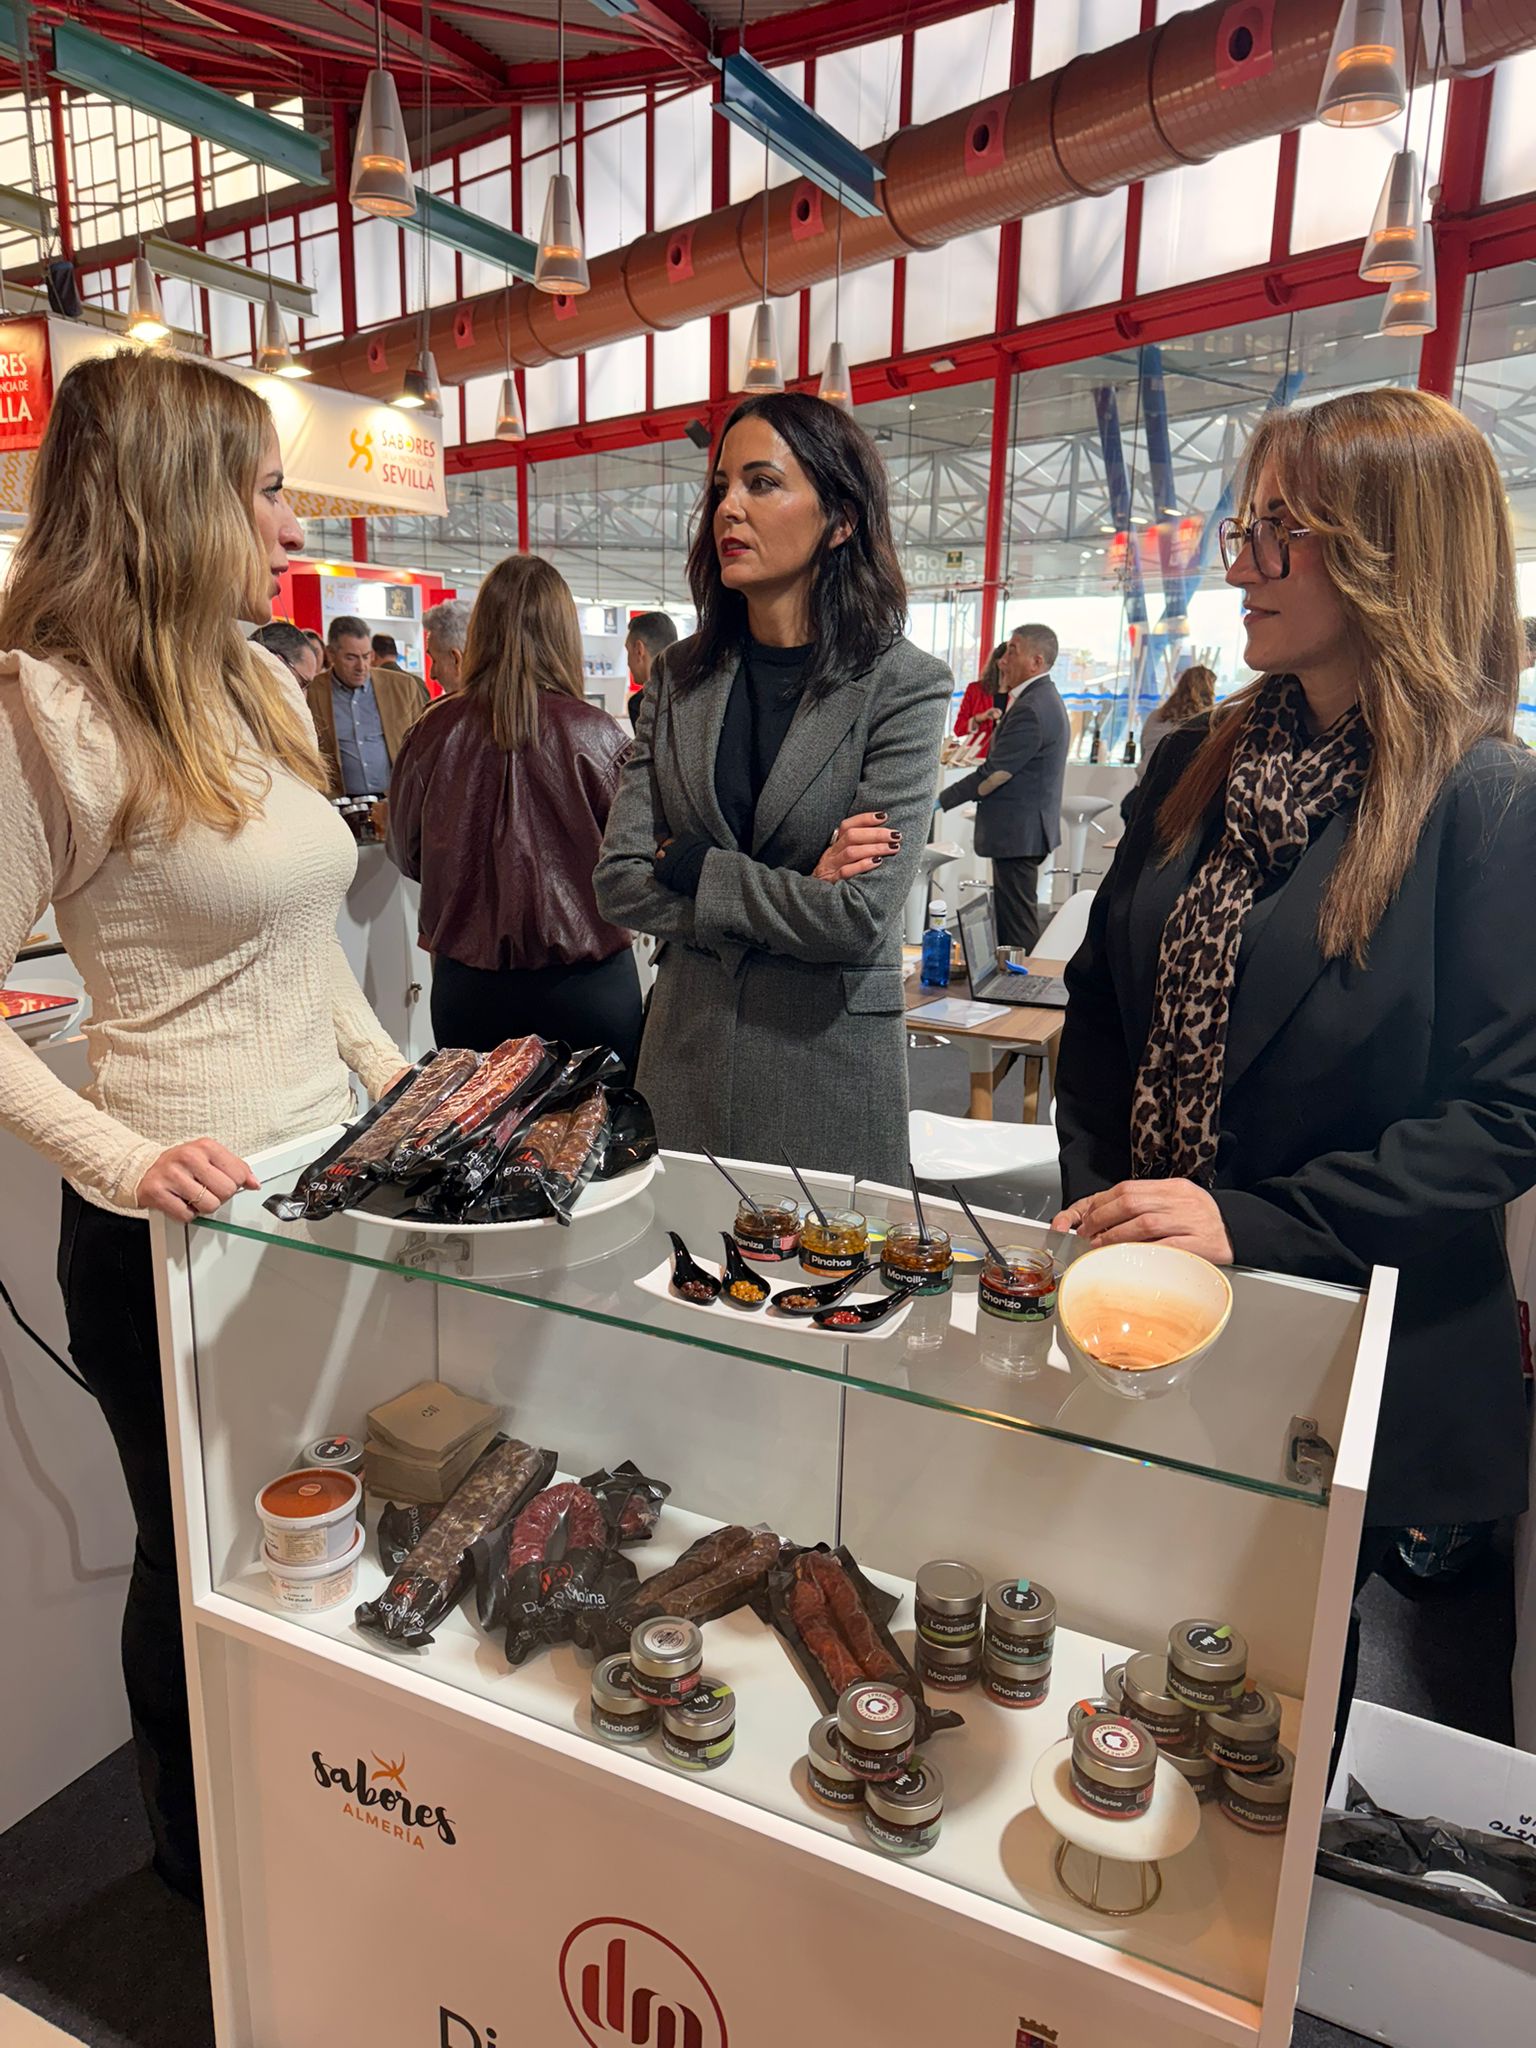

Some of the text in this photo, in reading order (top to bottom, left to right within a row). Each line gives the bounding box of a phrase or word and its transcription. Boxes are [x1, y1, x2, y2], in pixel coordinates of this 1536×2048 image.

[382, 430, 436, 458] SABORES
[383, 463, 436, 493] SEVILLA
[811, 1255, 852, 1267] Pinchos
[982, 1289, 1022, 1309] Chorizo
[565, 1588, 606, 1606] Molina
[930, 1620, 975, 1633] Longaniza
[991, 1635, 1030, 1654] Pinchos
[927, 1668, 967, 1681] Morcilla
[991, 1682, 1032, 1699] Chorizo
[1168, 1672, 1215, 1701] Longaniza
[600, 1719, 640, 1733] Pinchos
[841, 1749, 881, 1771] Morcilla
[1212, 1742, 1259, 1762] Pinchos
[311, 1751, 456, 1845] Sabores
[814, 1780, 855, 1800] Pinchos
[1229, 1800, 1283, 1822] Longaniza
[343, 1803, 425, 1850] ALMERÍA
[865, 1815, 903, 1843] Chorizo
